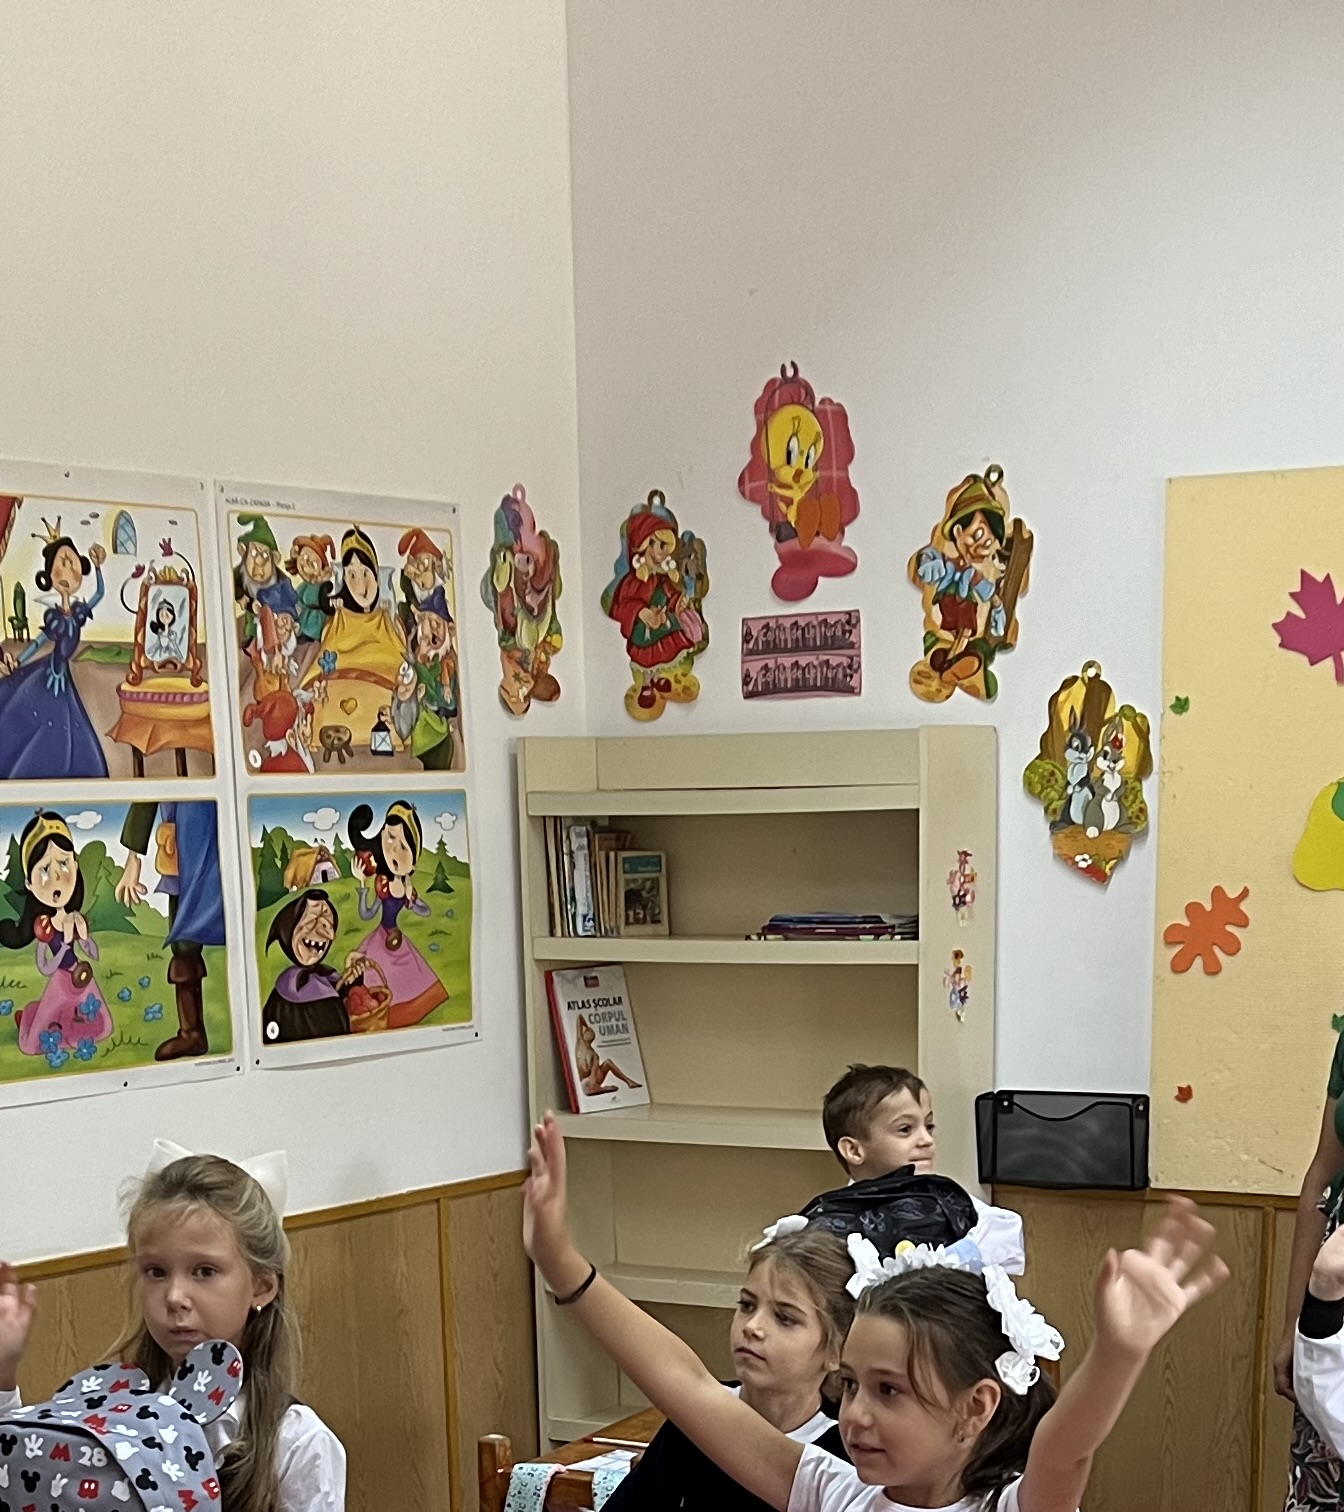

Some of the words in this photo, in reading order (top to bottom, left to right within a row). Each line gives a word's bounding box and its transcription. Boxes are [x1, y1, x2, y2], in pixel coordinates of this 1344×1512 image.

[567, 999, 591, 1011] ATLAS
[588, 1010, 627, 1024] CORPUL
[599, 1023, 629, 1036] UMAN
[78, 1446, 107, 1468] 28
